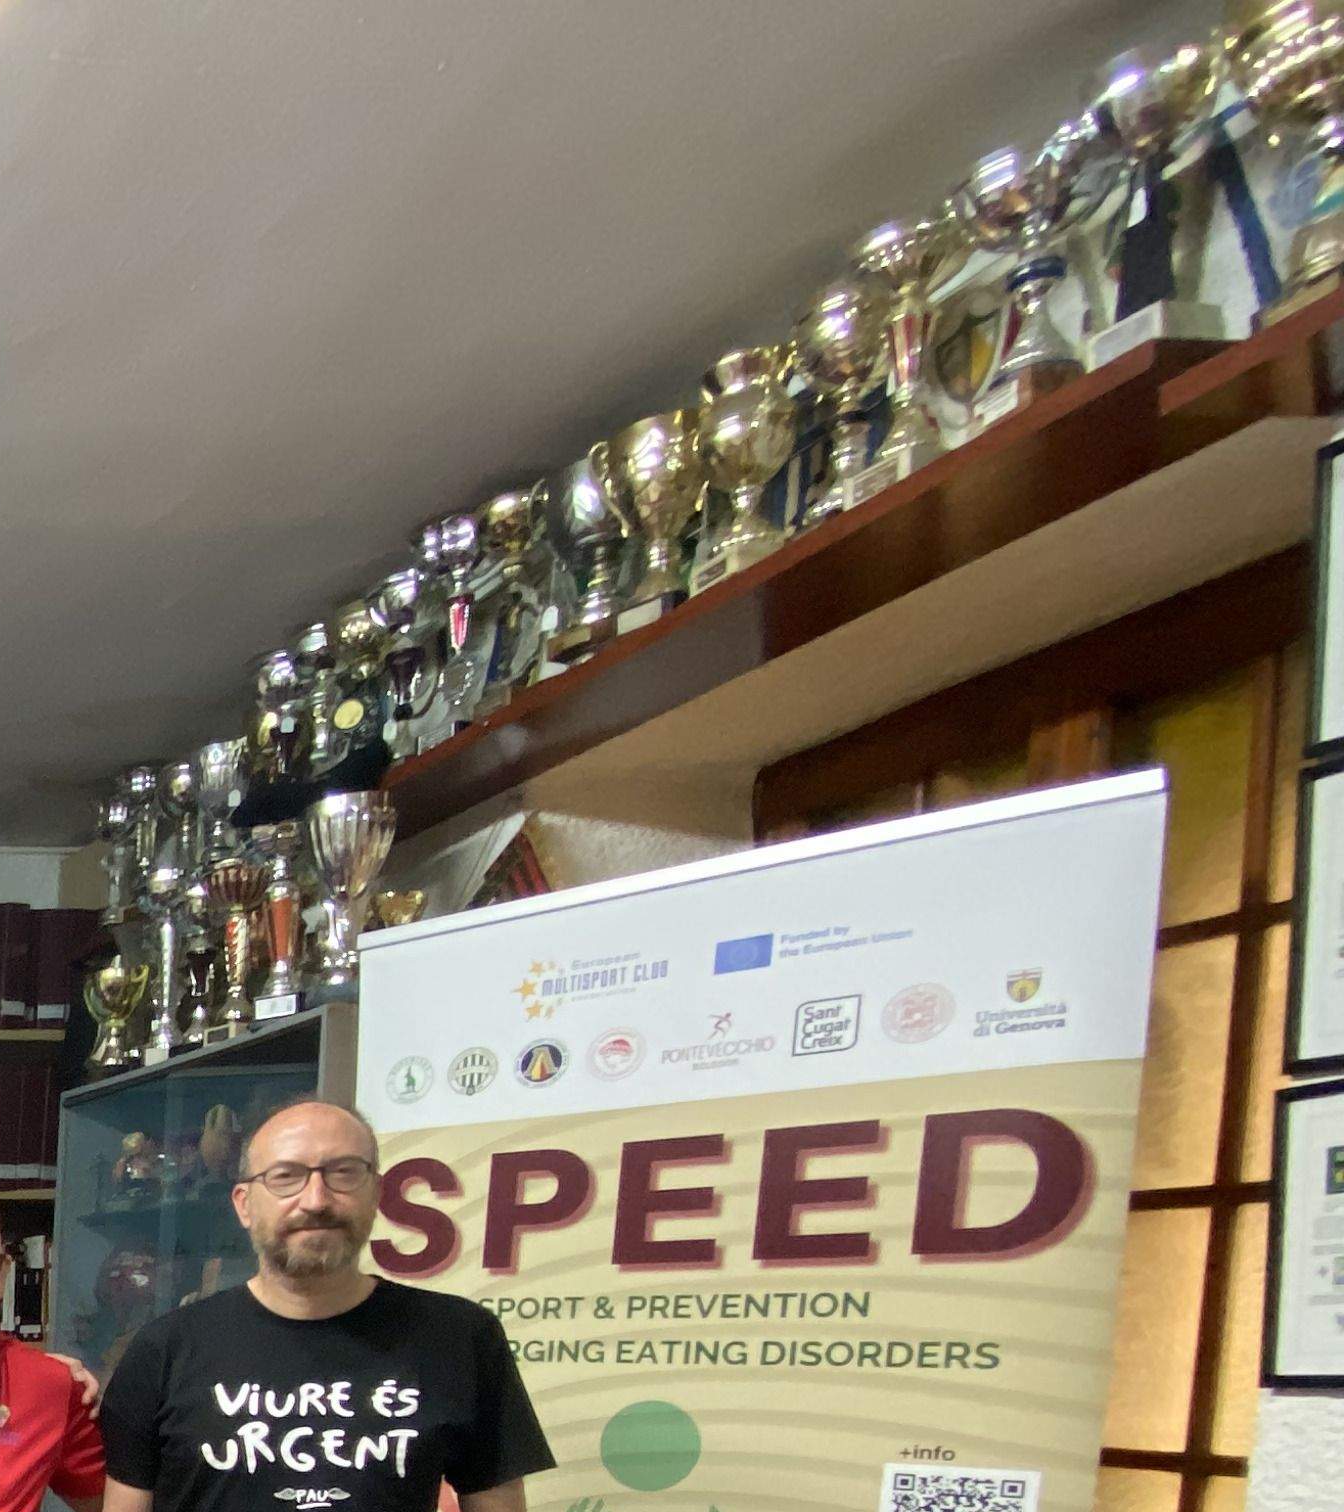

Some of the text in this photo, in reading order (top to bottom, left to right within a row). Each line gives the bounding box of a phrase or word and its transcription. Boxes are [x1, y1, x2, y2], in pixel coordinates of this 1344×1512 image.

[541, 966, 627, 997] MULTISPORT
[370, 1108, 1094, 1279] SPEED
[478, 1291, 870, 1320] SPORT & PREVENTION
[615, 1340, 748, 1366] EATING
[759, 1340, 1001, 1370] DISORDERS
[200, 1421, 419, 1478] URGENT
[899, 1444, 956, 1462] +info
[295, 1488, 330, 1503] PAU
